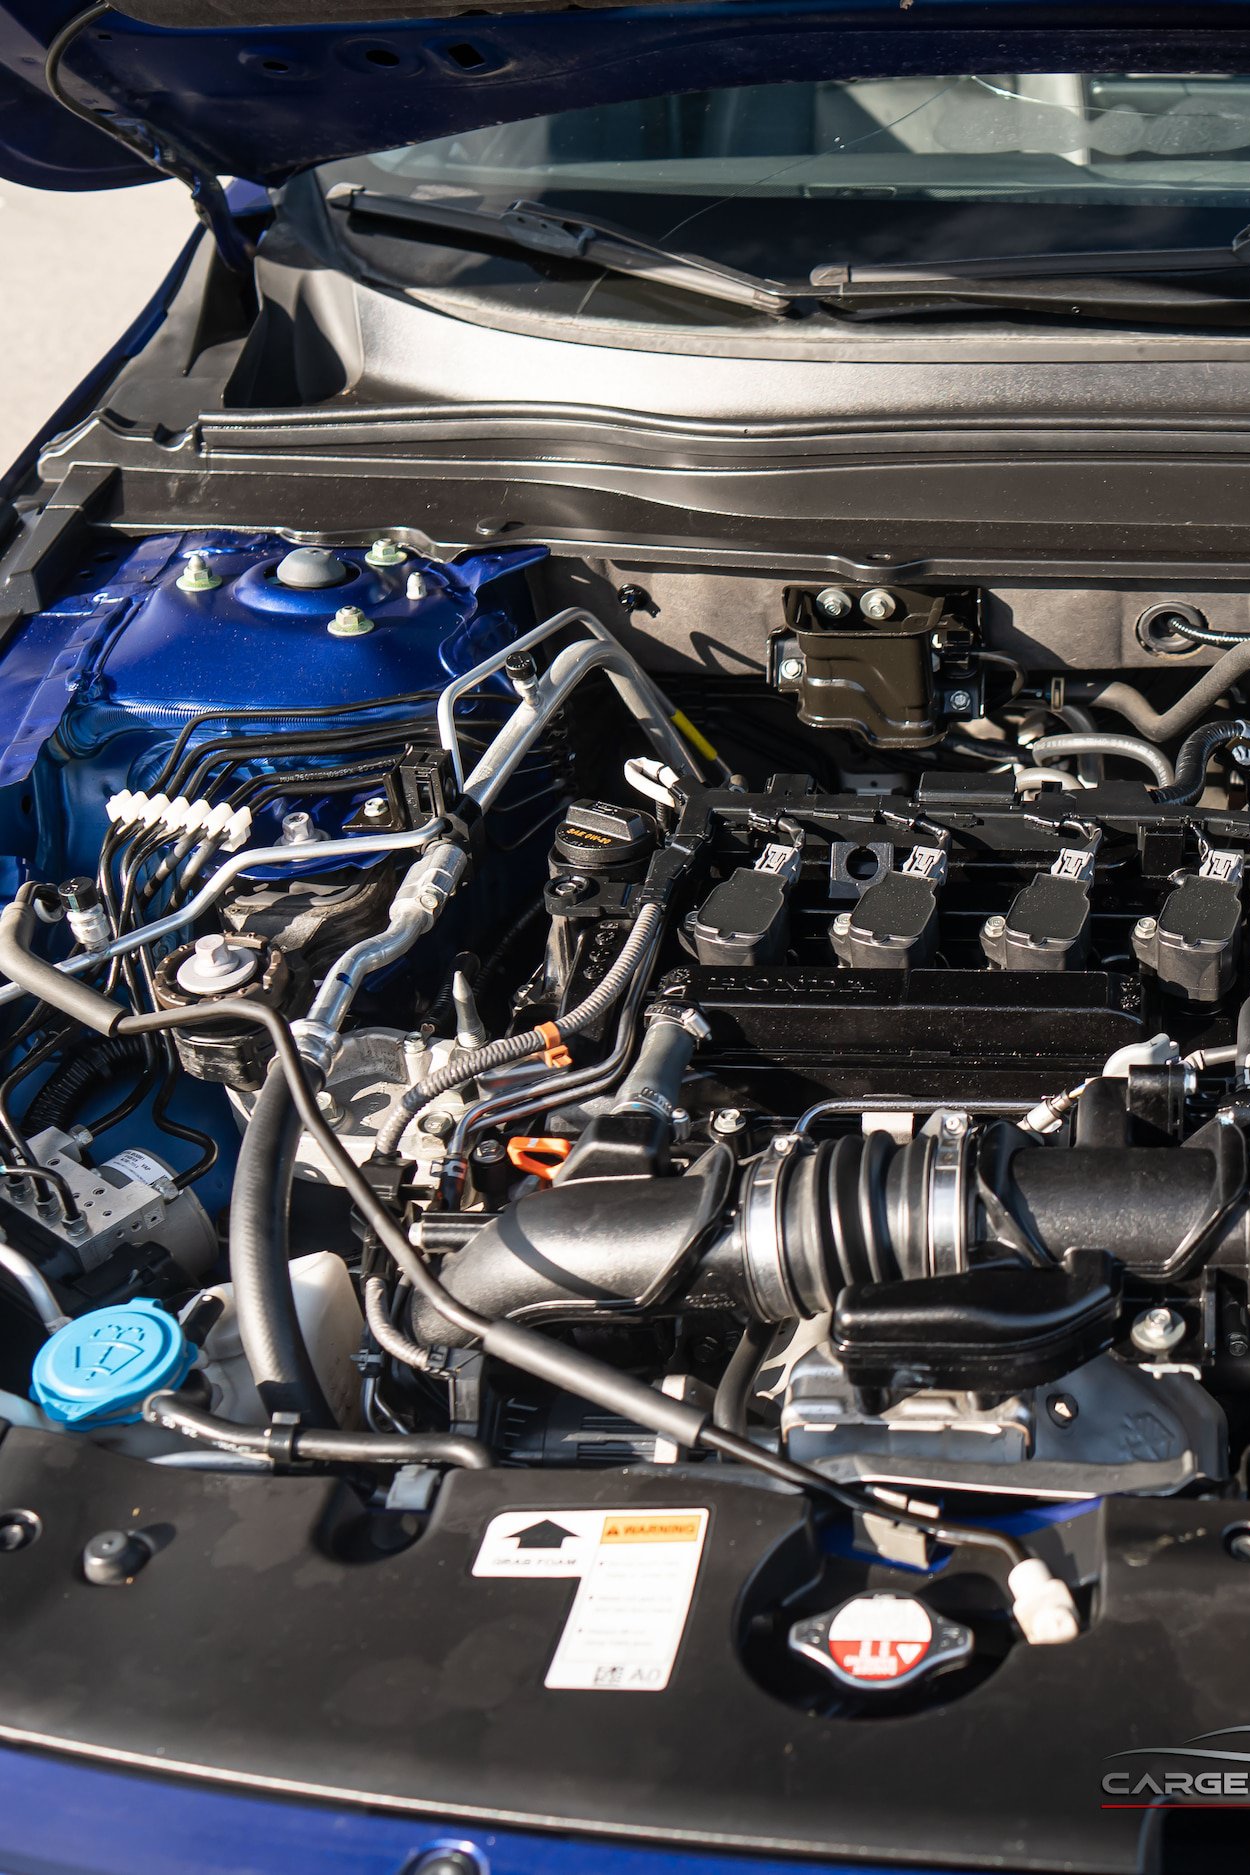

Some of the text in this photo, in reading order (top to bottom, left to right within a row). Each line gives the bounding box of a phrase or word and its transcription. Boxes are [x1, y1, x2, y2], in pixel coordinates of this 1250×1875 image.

[566, 827, 612, 845] SAE 0W-20
[707, 976, 878, 993] HONDA
[623, 1524, 695, 1536] WARNING
